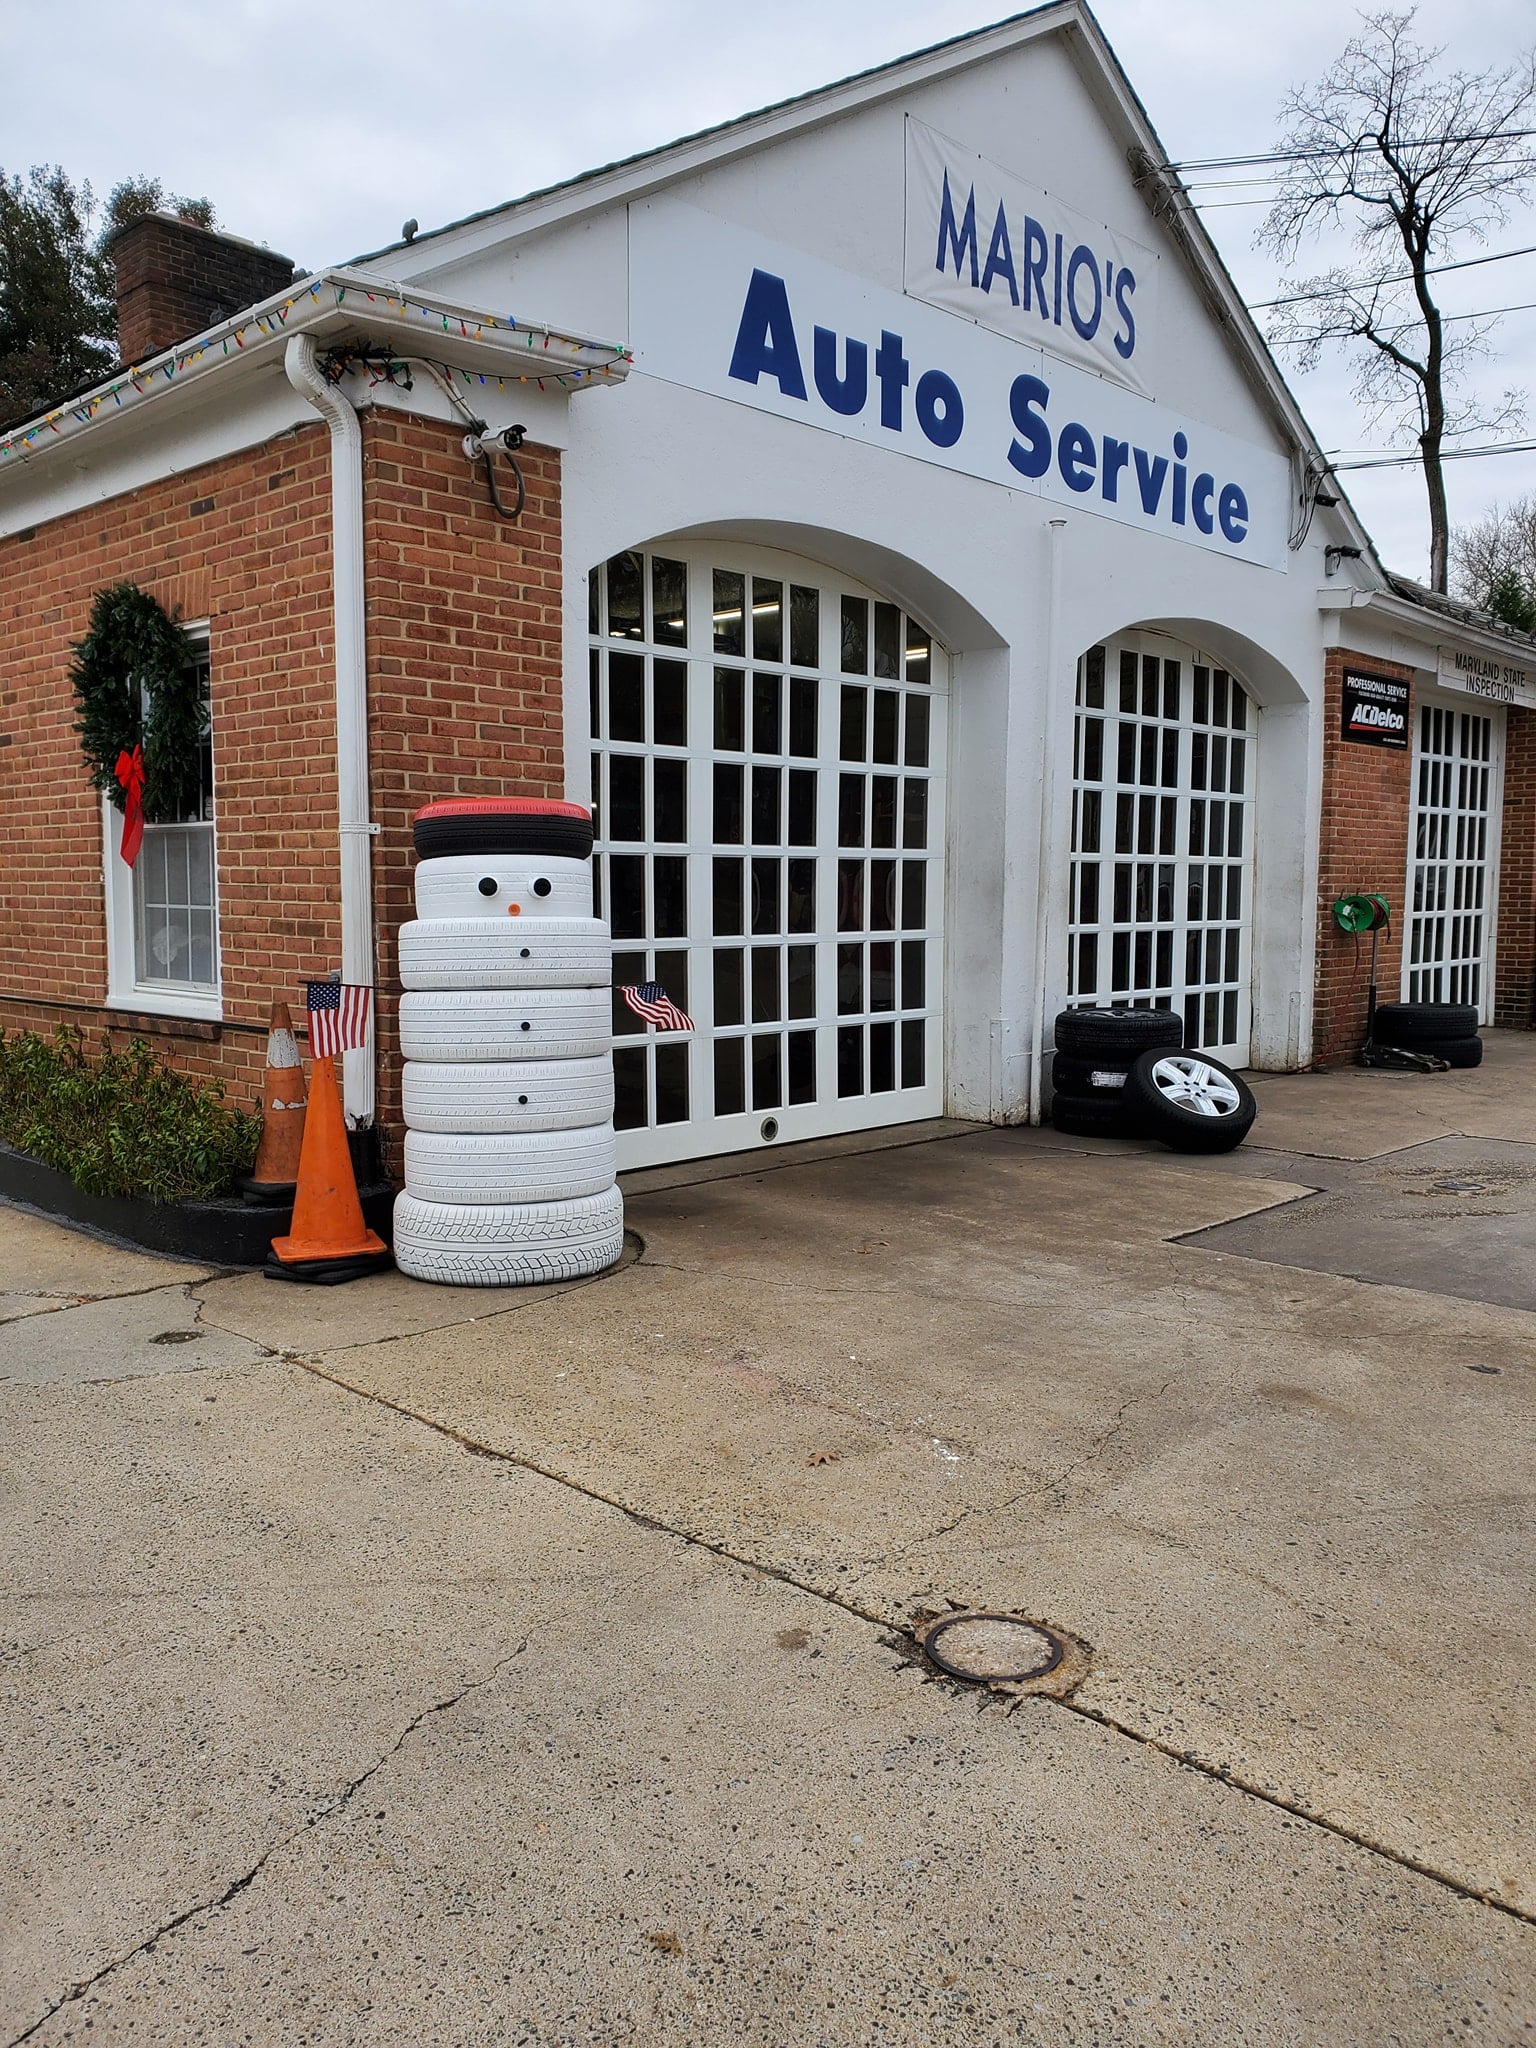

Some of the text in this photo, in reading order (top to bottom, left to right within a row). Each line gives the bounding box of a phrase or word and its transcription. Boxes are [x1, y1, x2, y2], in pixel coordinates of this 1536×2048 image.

[936, 167, 1137, 359] MARIO'S
[728, 268, 1249, 543] Auto Service
[1455, 653, 1526, 687] MARYLAND STATE
[1347, 676, 1386, 694] PROFESSIONAL
[1387, 685, 1407, 698] SERVICE
[1466, 675, 1515, 702] INSPECTION
[1351, 703, 1404, 730] ACDelco
